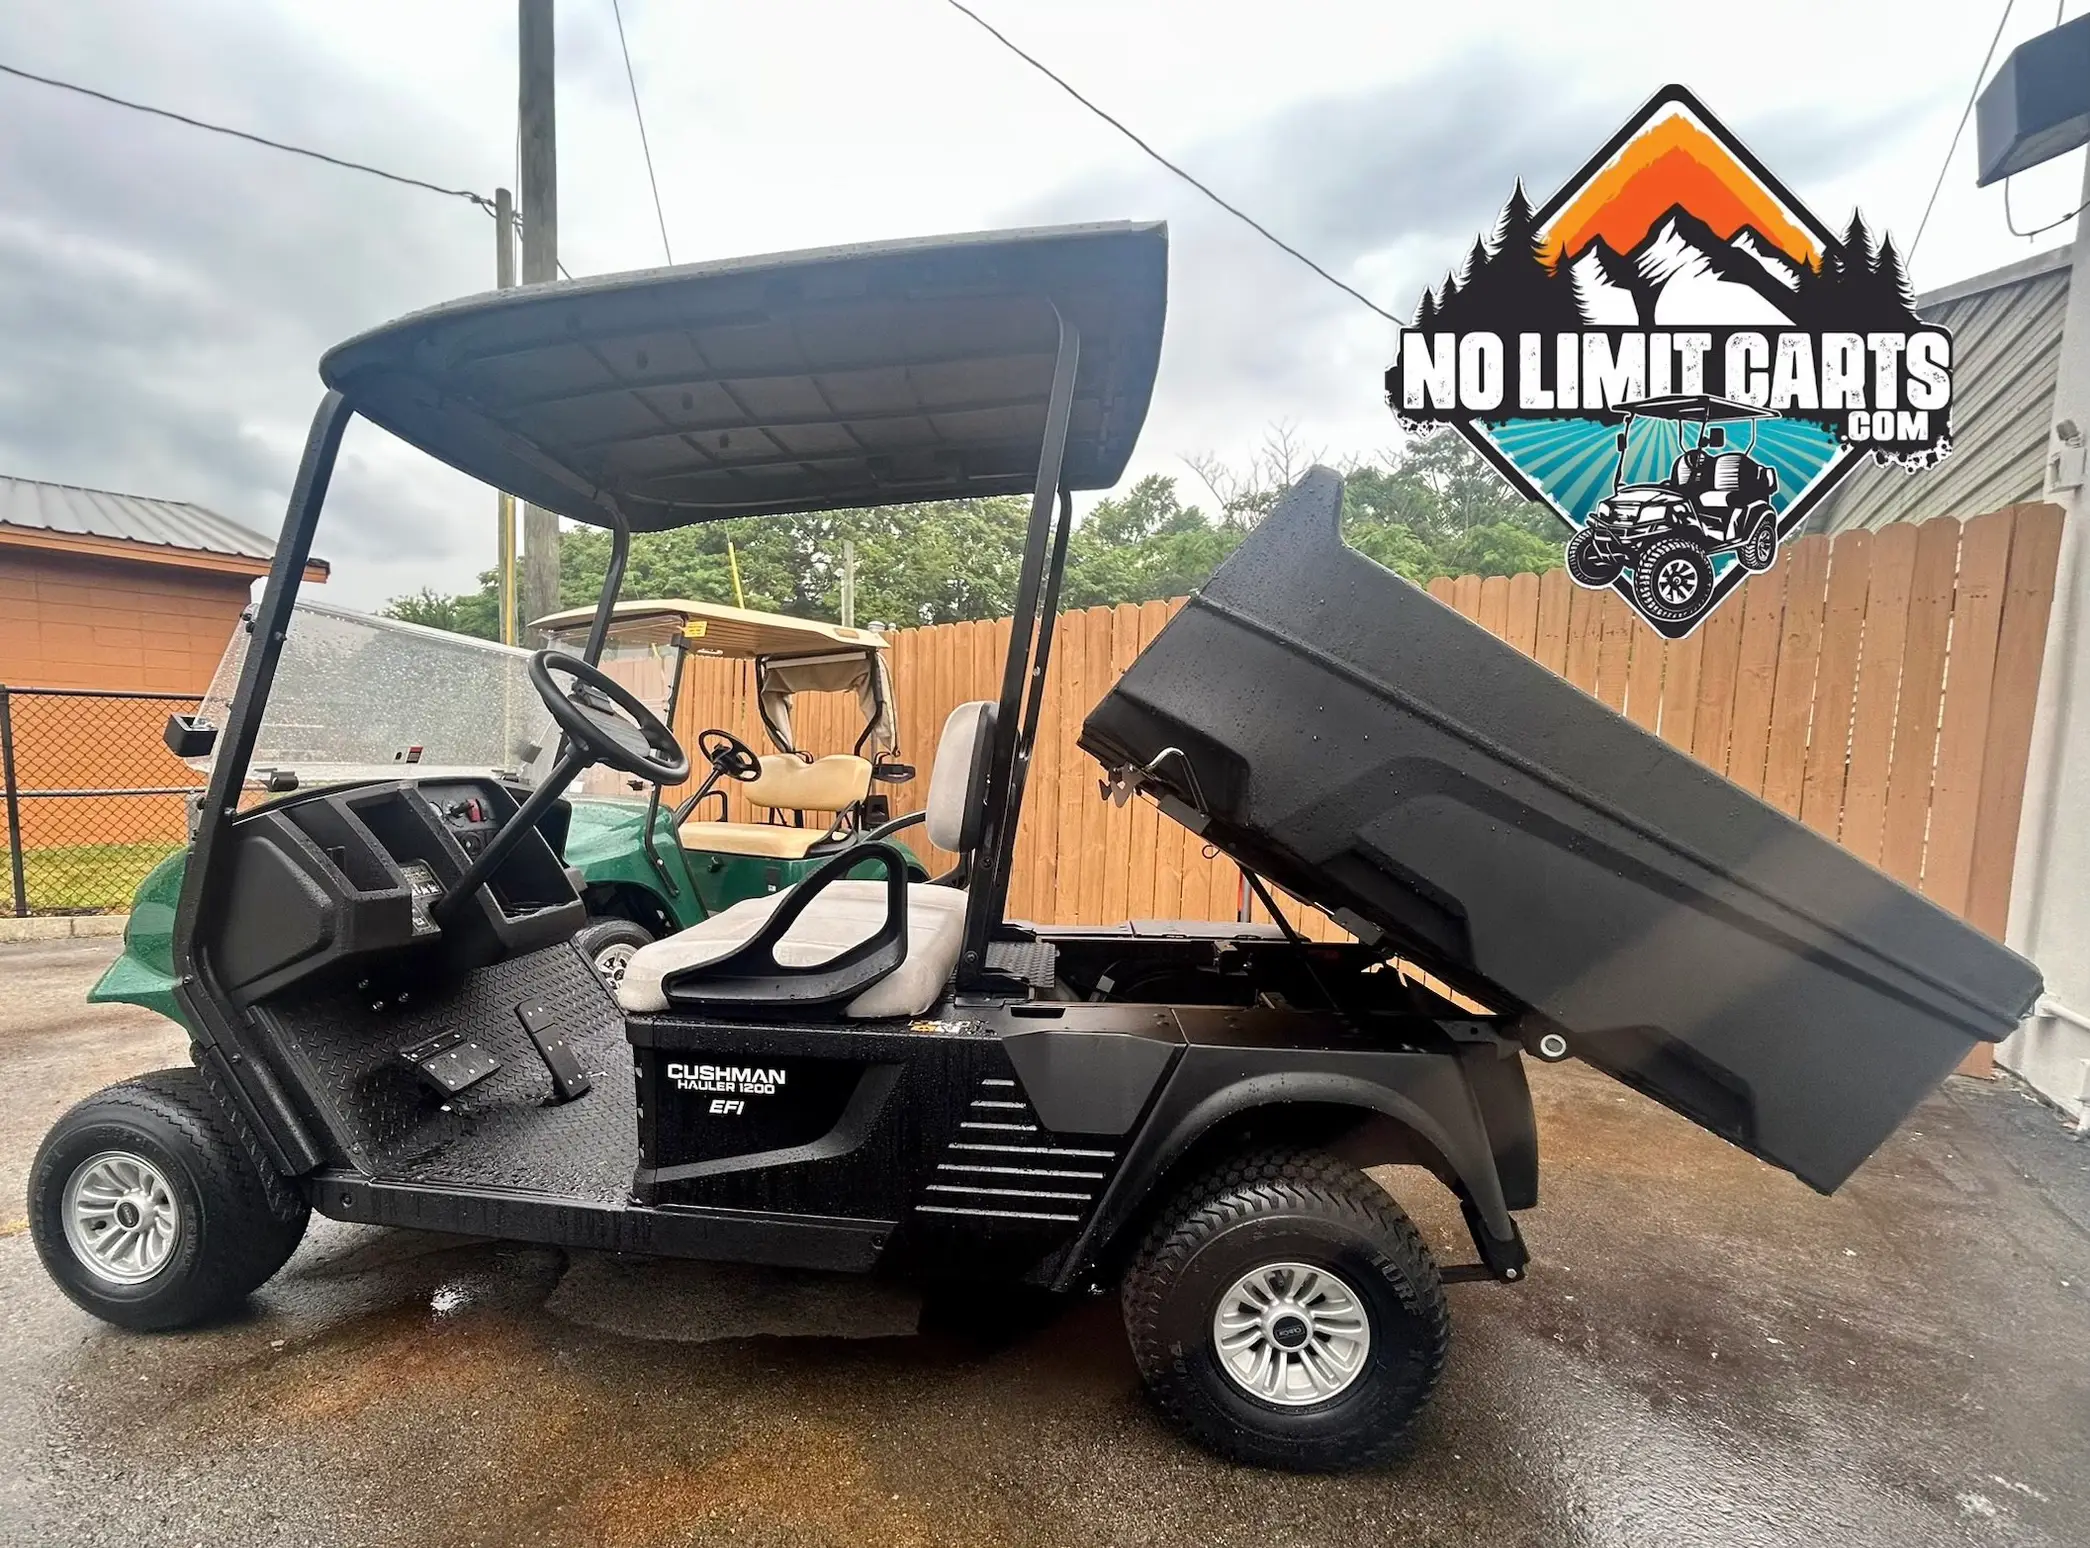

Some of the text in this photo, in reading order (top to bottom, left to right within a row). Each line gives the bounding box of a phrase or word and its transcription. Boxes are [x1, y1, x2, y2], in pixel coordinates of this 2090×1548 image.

[667, 1063, 786, 1085] CUSHMAN
[677, 1079, 776, 1095] HAULER 1200
[709, 1099, 745, 1116] EFI
